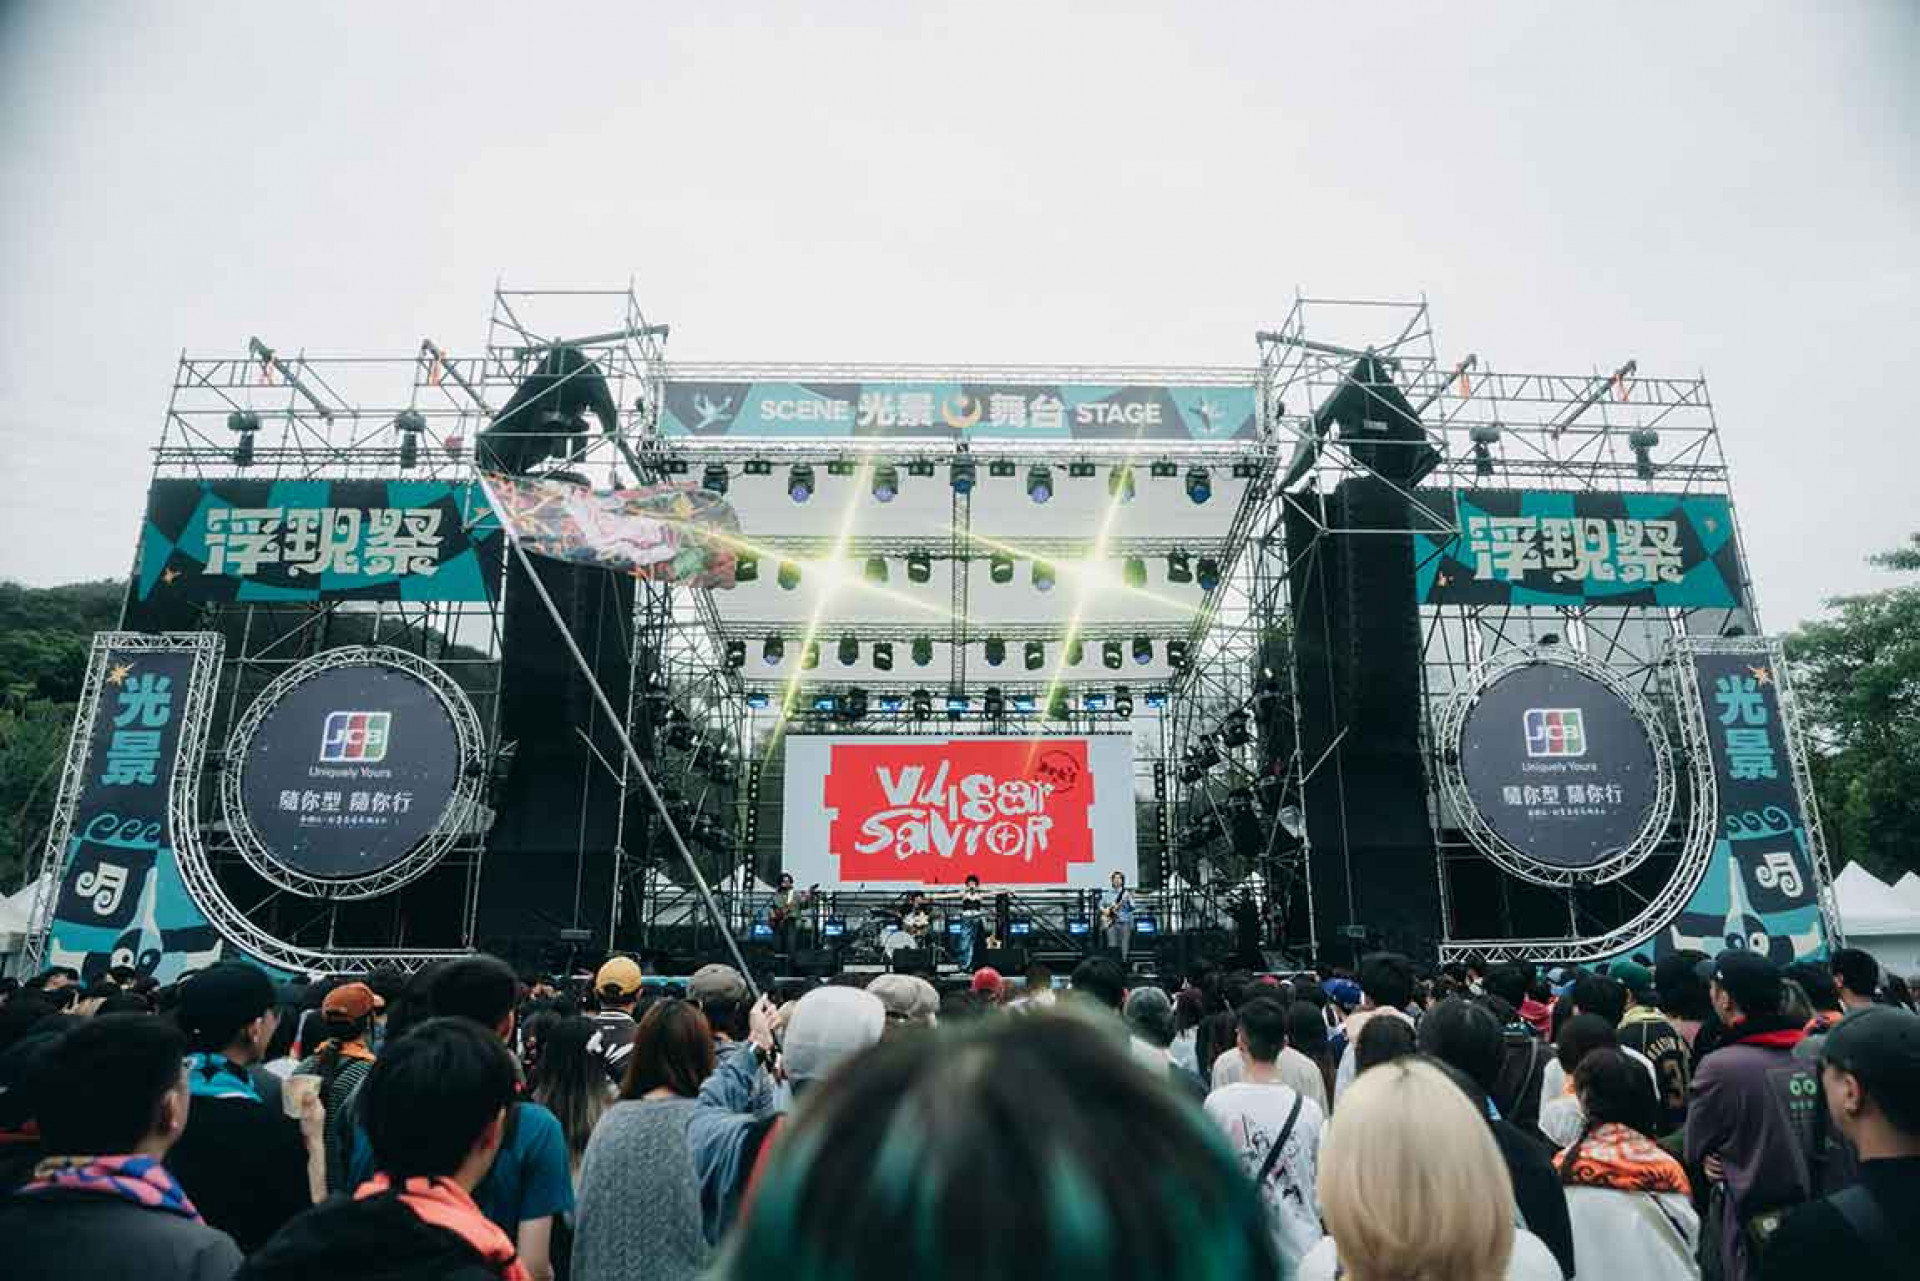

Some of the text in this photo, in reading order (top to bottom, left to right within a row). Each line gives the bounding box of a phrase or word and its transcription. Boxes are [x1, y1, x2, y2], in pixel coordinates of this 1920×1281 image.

[760, 392, 1163, 428] SCENE 光景 舞台 STAGE
[202, 507, 444, 577] 浮現祭
[1468, 516, 1684, 584] 浮現祭
[101, 673, 172, 786] 光景
[1715, 674, 1778, 780] 光景
[360, 766, 392, 778] Yours
